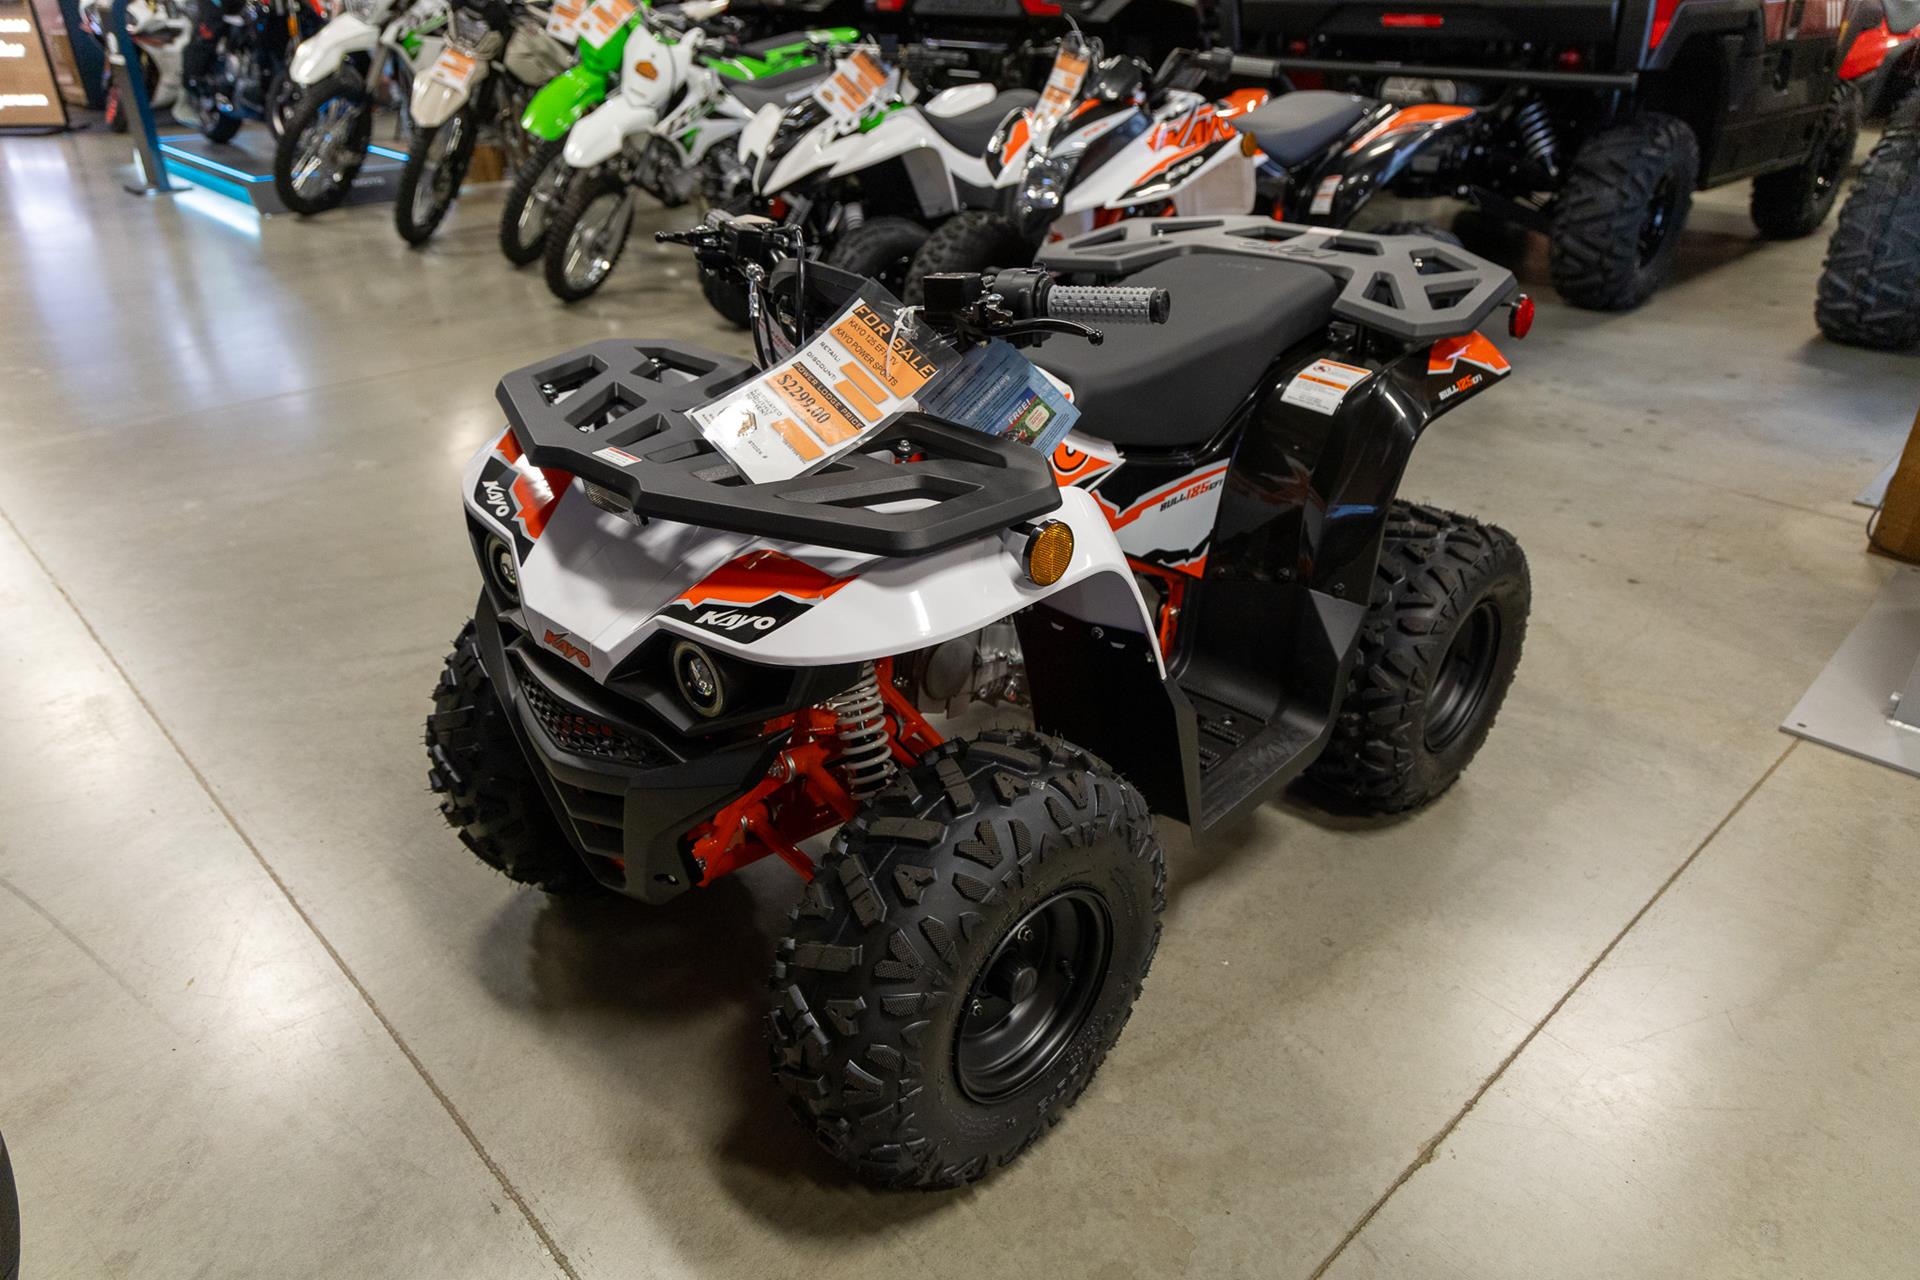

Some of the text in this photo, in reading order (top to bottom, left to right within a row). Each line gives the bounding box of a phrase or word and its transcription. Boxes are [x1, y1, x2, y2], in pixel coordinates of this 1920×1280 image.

[834, 326, 853, 344] KAYO
[850, 341, 874, 364] POWER
[848, 318, 866, 336] KAYO
[864, 333, 877, 346] 125
[855, 305, 936, 378] FOR SALE
[777, 374, 832, 424] $2299.00
[793, 362, 863, 429] POWER LODGE PRICE
[1009, 399, 1031, 424] FREE!
[482, 480, 510, 517] KAYO
[694, 608, 776, 630] KAYO
[543, 628, 591, 668] KAYO
